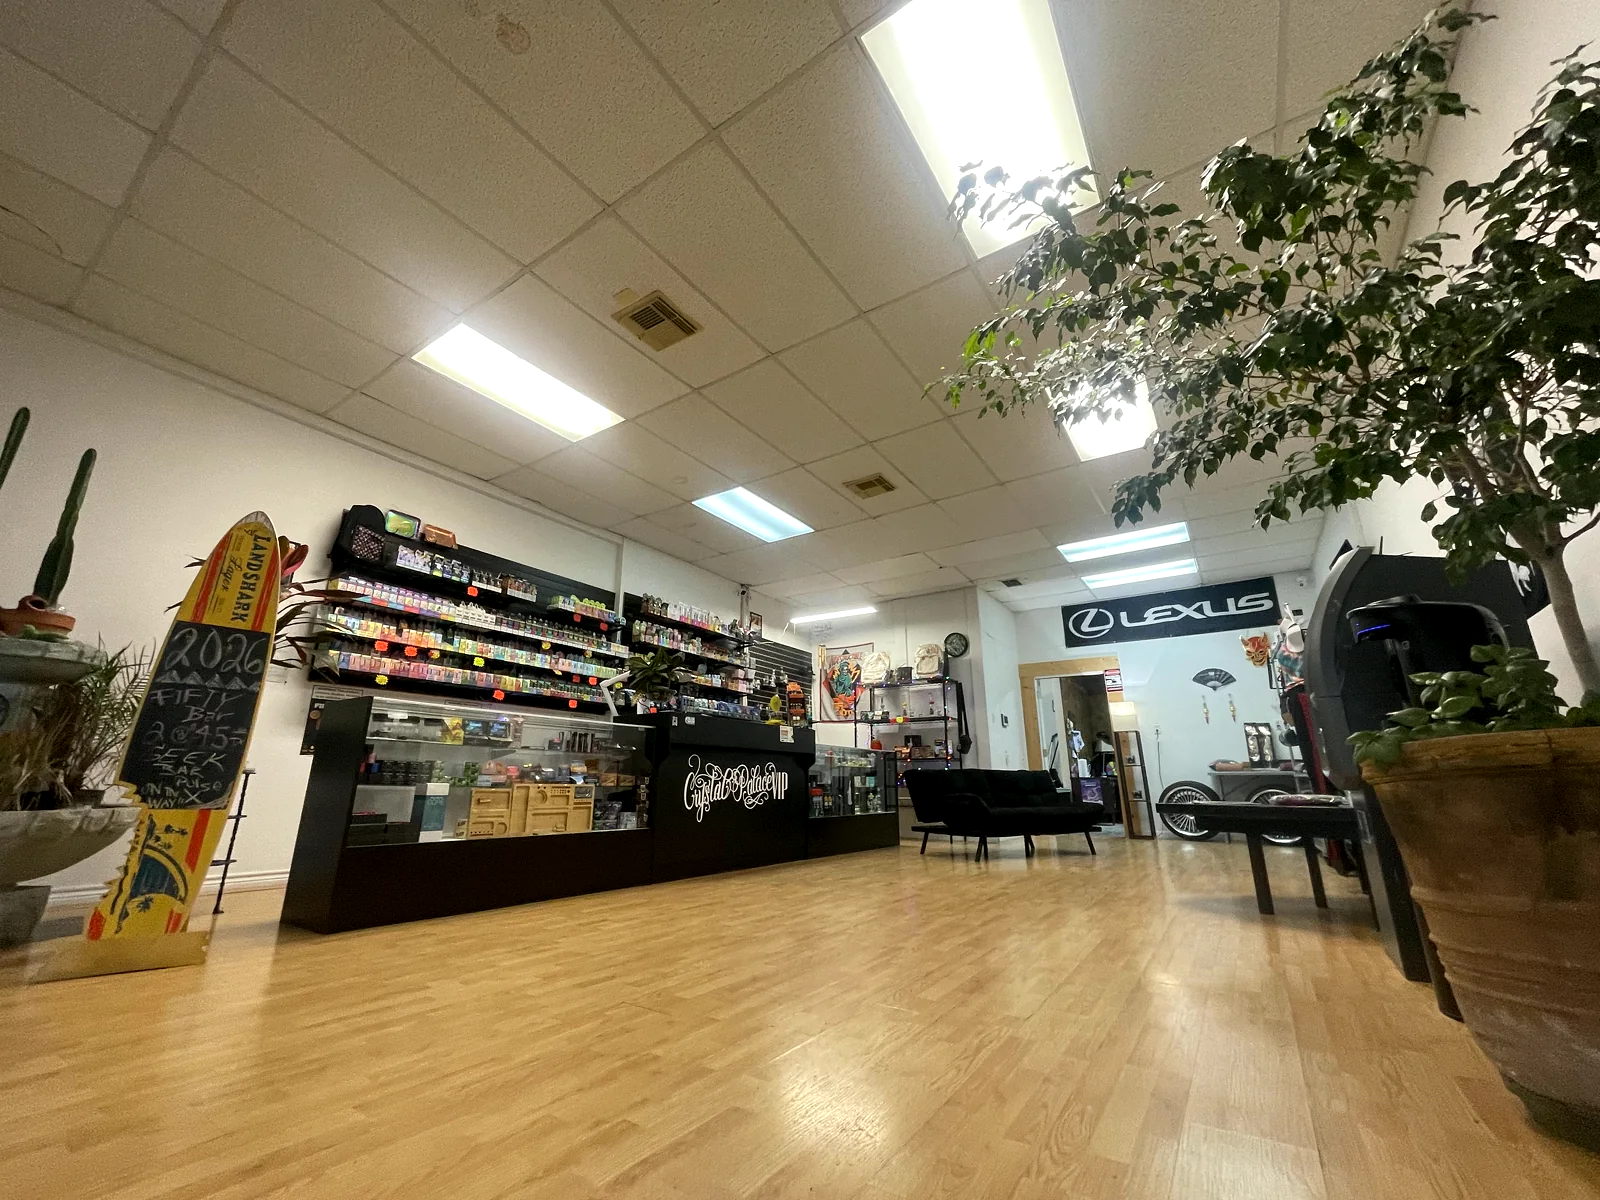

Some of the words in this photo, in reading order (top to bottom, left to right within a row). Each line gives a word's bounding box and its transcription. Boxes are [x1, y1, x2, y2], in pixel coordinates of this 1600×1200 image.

[221, 555, 243, 592] Lager
[230, 534, 271, 622] LANDSHARK
[1120, 592, 1274, 628] LEXUS
[165, 628, 267, 674] 2026
